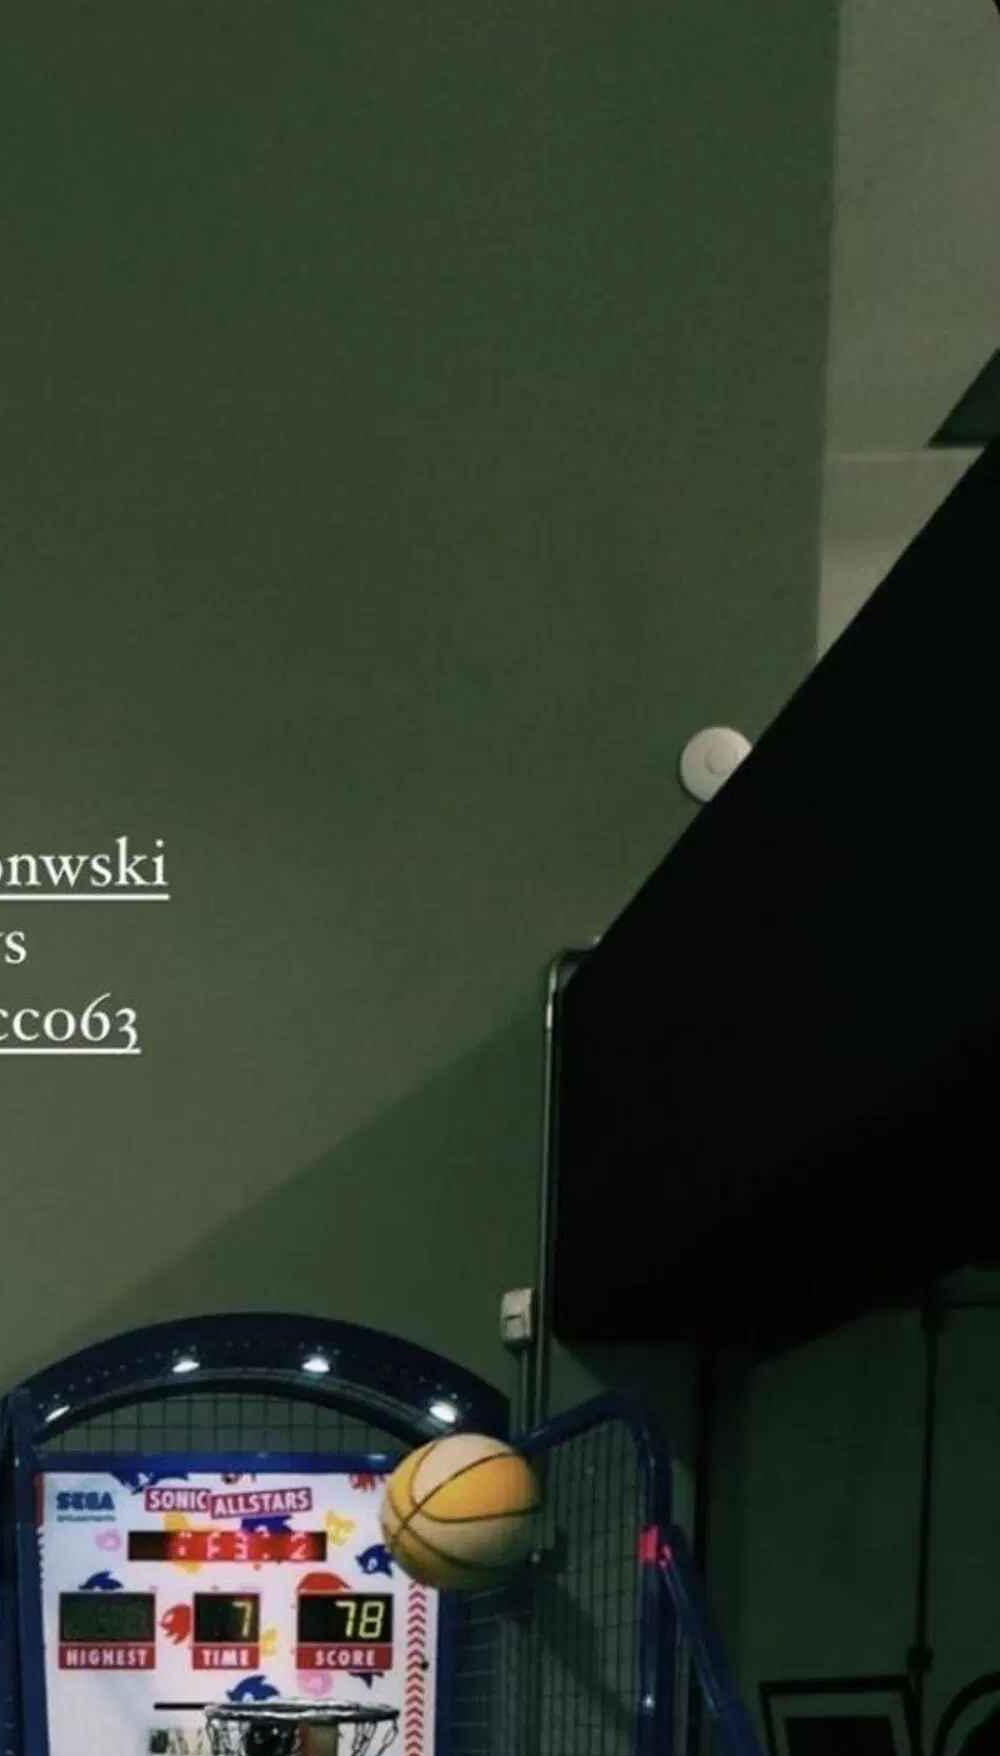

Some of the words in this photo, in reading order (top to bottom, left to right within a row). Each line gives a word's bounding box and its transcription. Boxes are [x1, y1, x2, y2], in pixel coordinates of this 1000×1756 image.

[56, 1490, 116, 1511] SEGA
[149, 1490, 208, 1510] SONIC
[214, 1490, 310, 1517] ALLSTARS
[231, 1600, 253, 1639] 7
[334, 1600, 385, 1639] 78
[65, 1649, 149, 1668] HIGHEST
[203, 1649, 249, 1668] TIME
[315, 1648, 375, 1667] SCORE
